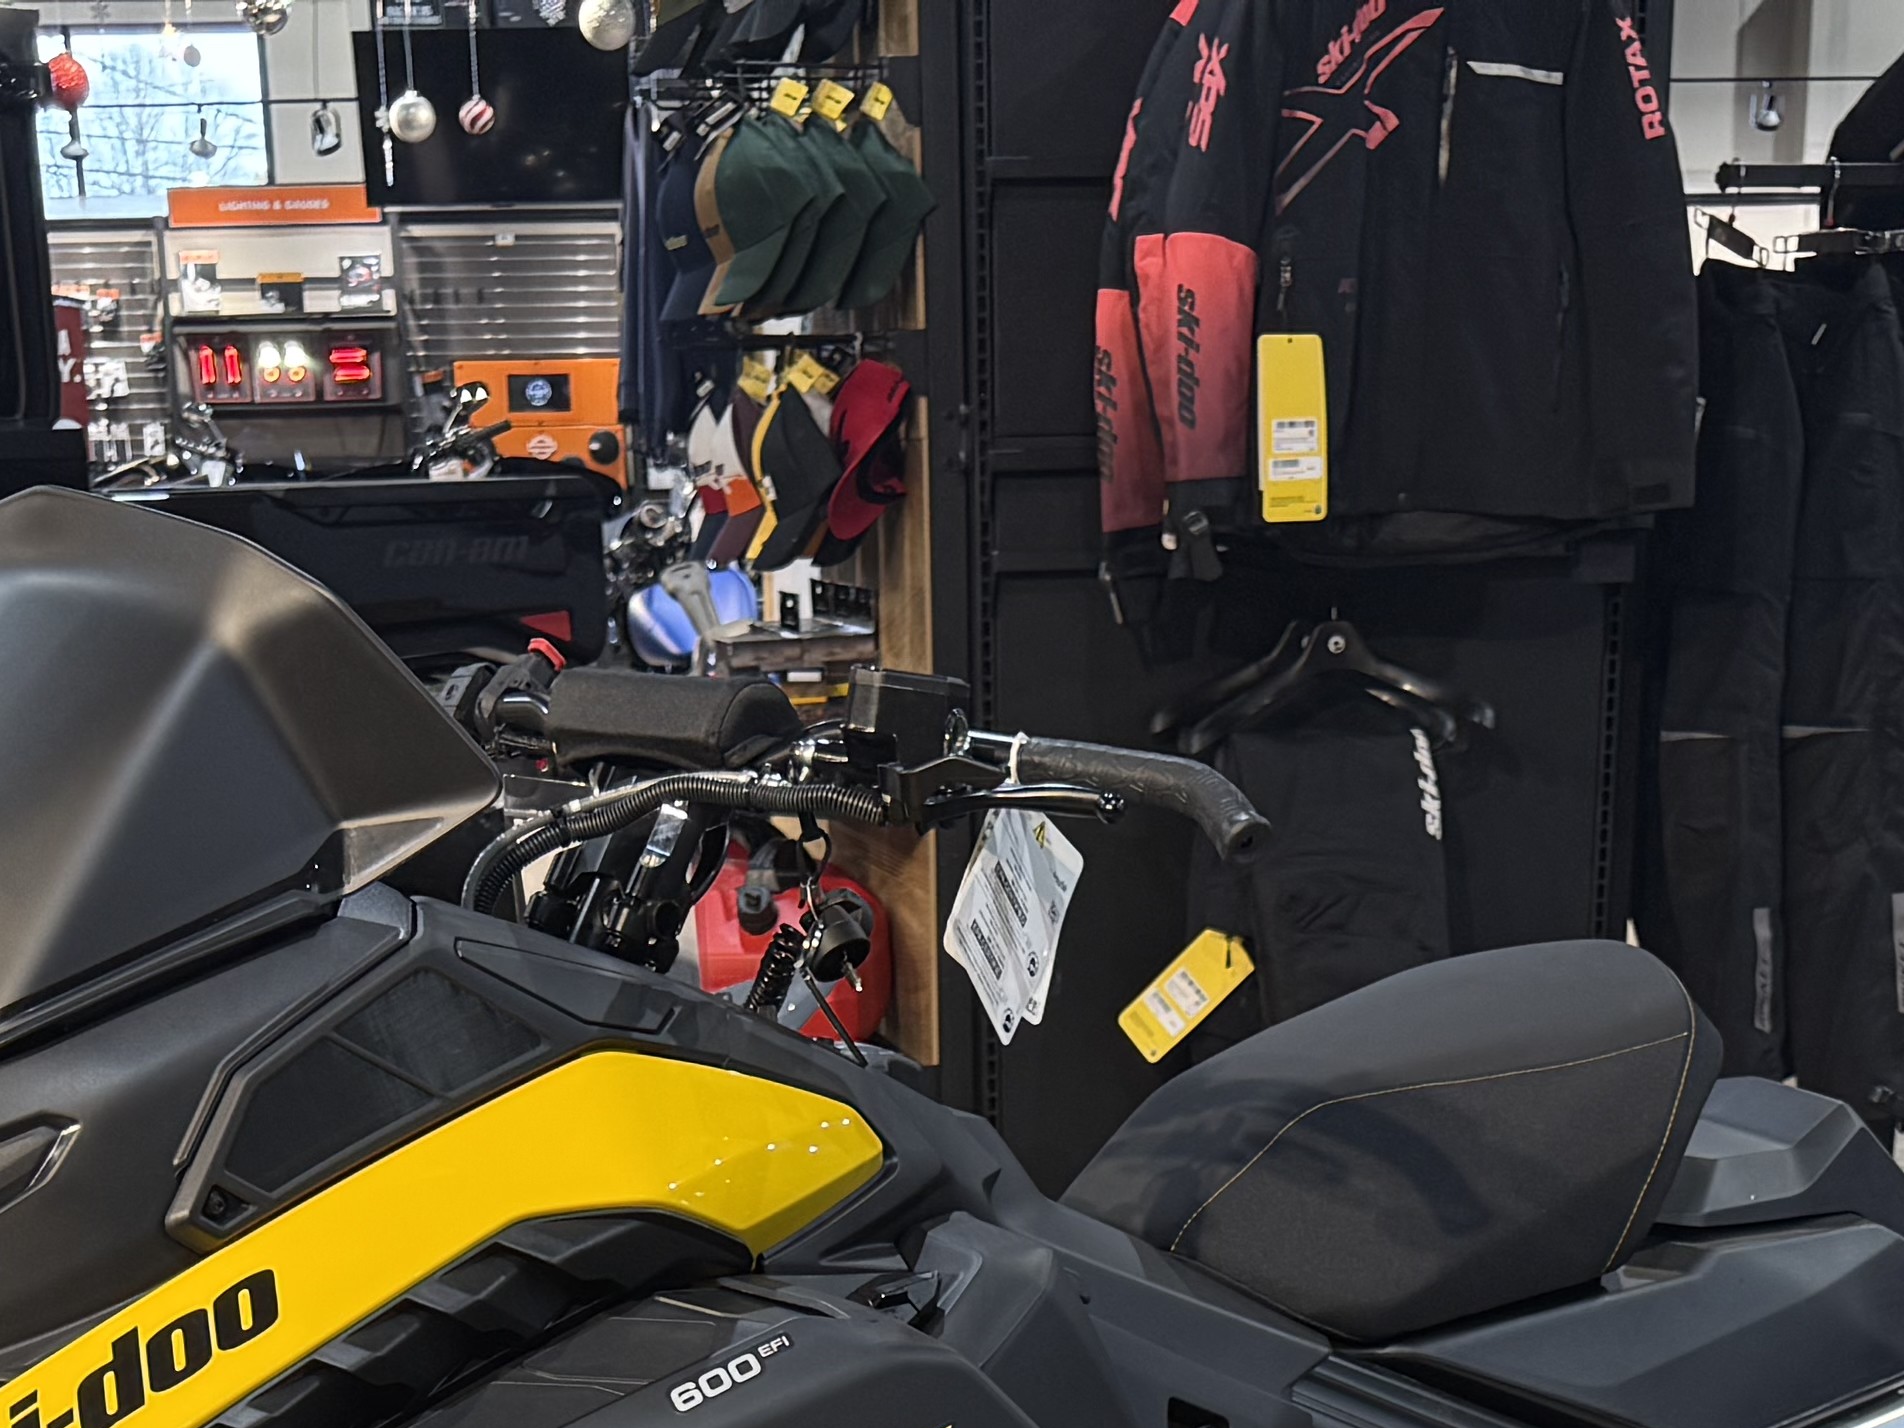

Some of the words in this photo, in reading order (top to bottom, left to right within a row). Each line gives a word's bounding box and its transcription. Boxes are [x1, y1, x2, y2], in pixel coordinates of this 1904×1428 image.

[1615, 16, 1666, 140] ROTAX
[1176, 283, 1201, 431] ski-doo
[669, 1352, 762, 1413] 600
[757, 1335, 791, 1358] EFI
